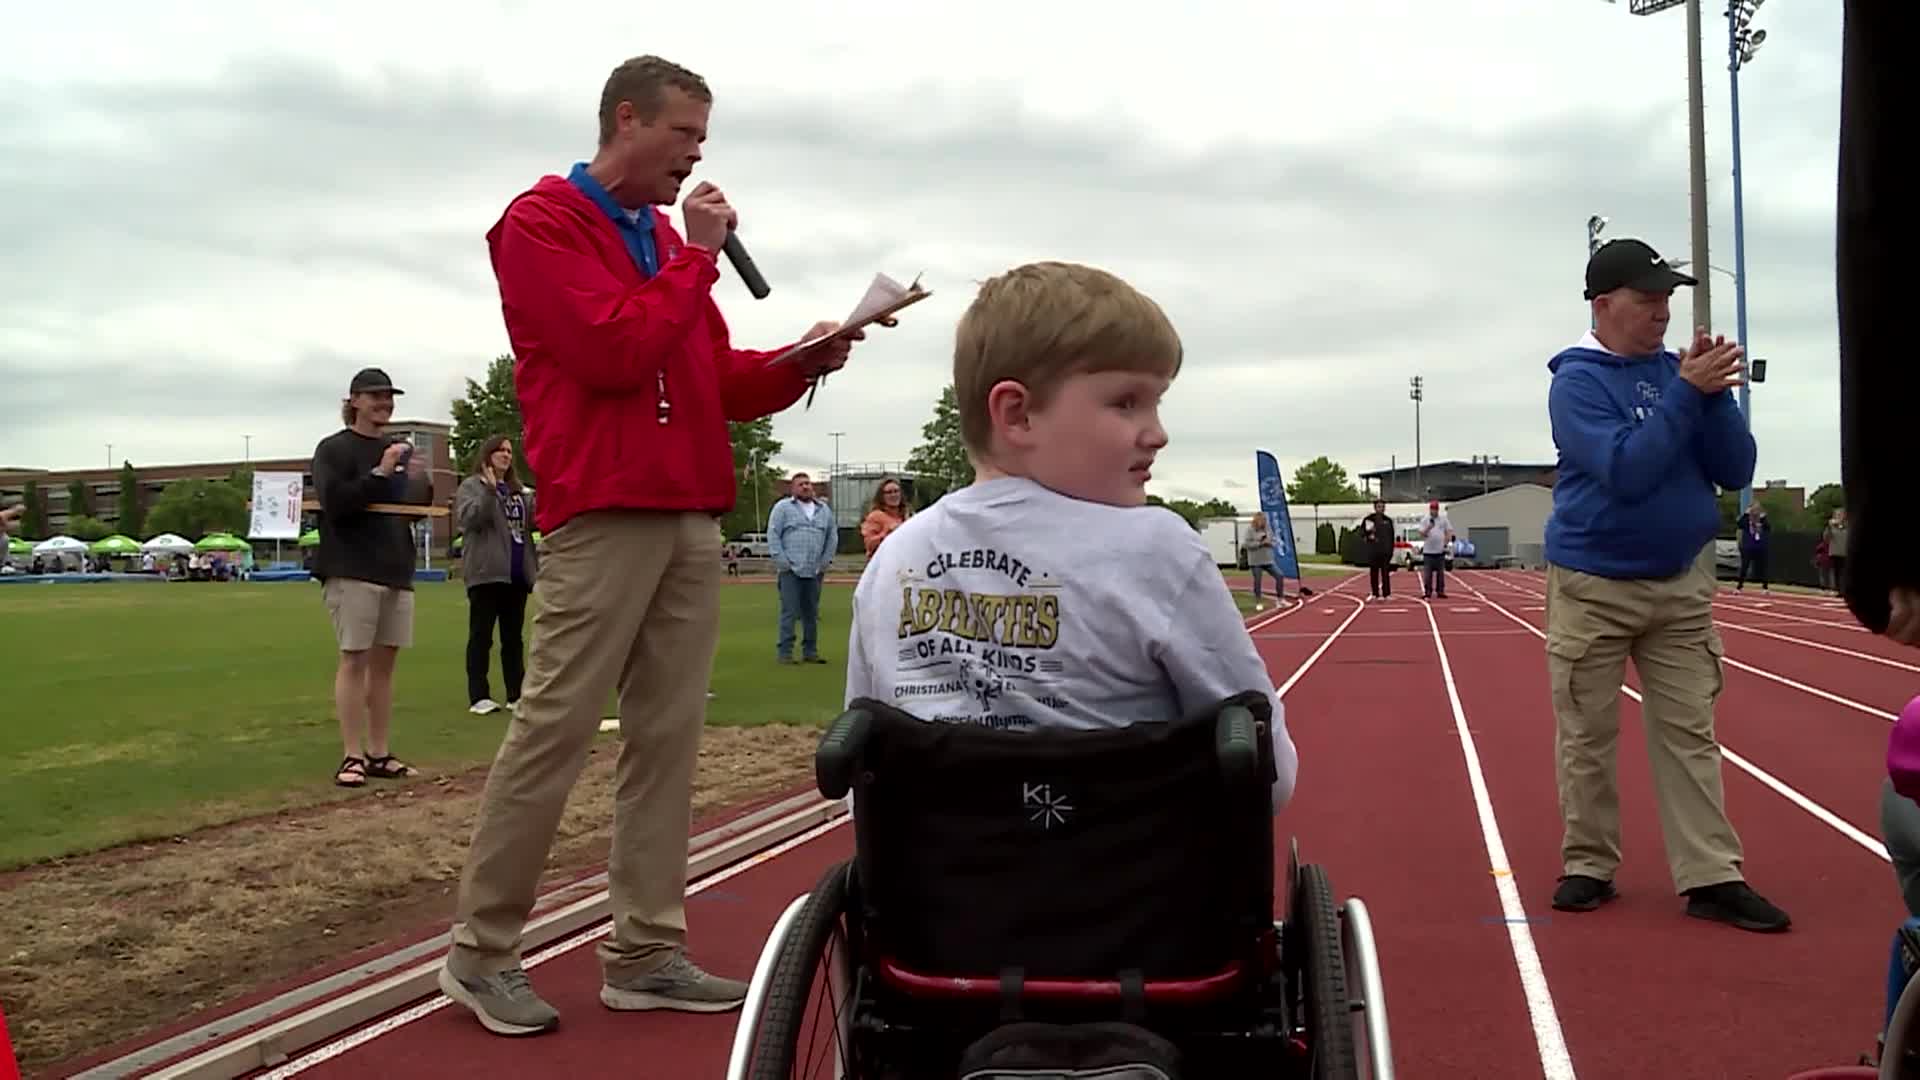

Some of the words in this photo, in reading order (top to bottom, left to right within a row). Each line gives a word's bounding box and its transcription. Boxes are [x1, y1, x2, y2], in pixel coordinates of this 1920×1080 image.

[926, 549, 1031, 587] CELEBRATE
[898, 587, 1059, 650] ABILITIES
[917, 639, 936, 659] OF
[941, 638, 975, 655] ALL
[894, 680, 964, 698] CHRISTIANA
[1023, 781, 1050, 804] Ki
